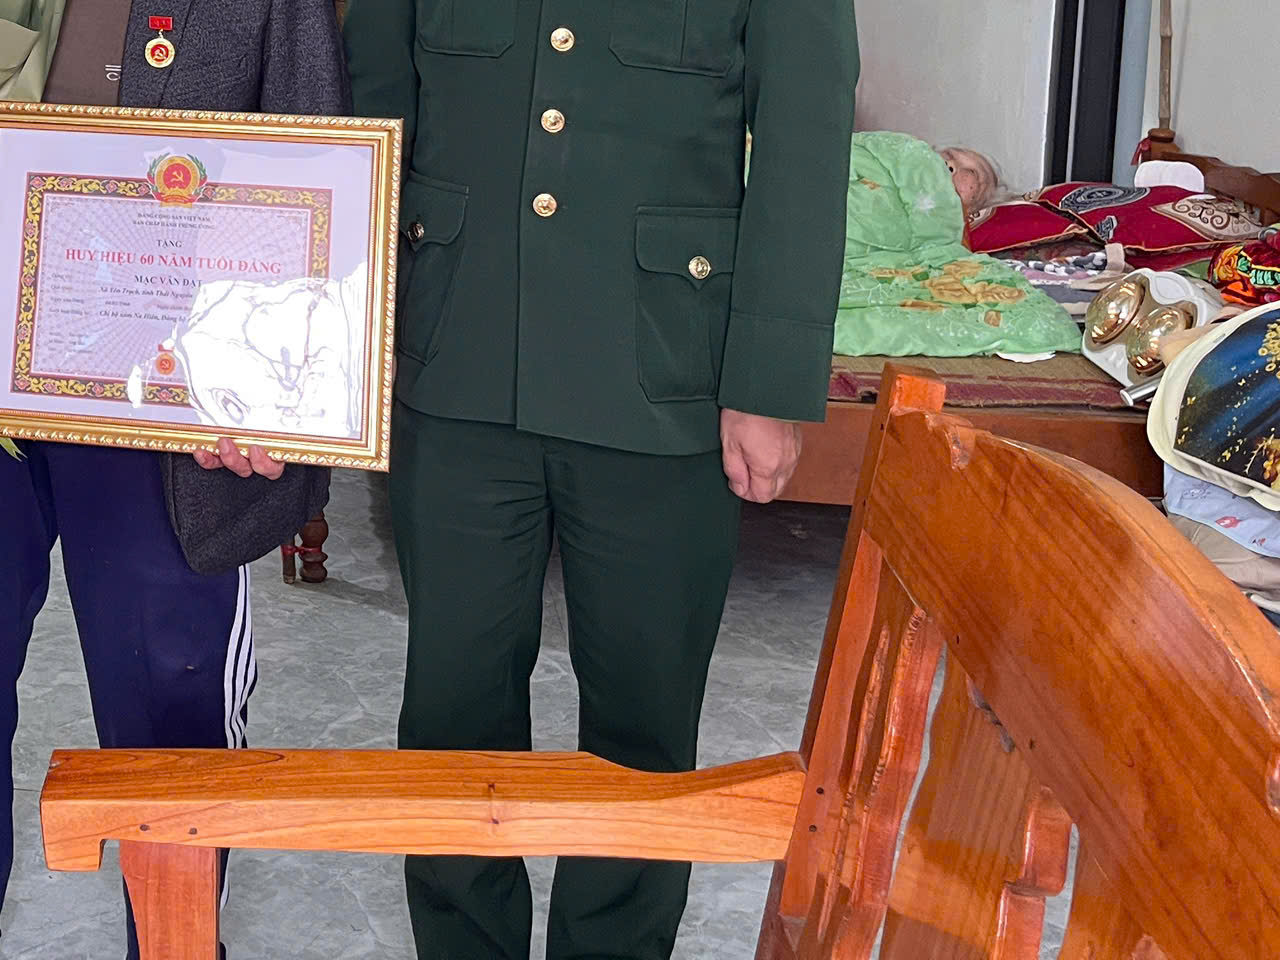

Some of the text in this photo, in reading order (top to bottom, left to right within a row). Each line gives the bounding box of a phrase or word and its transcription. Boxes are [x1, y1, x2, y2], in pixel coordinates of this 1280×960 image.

[65, 248, 281, 274] HUY HIỆU 60 NĂM TUỔI ĐẢNG
[135, 275, 157, 285] MẠC
[159, 275, 180, 285] VĂN
